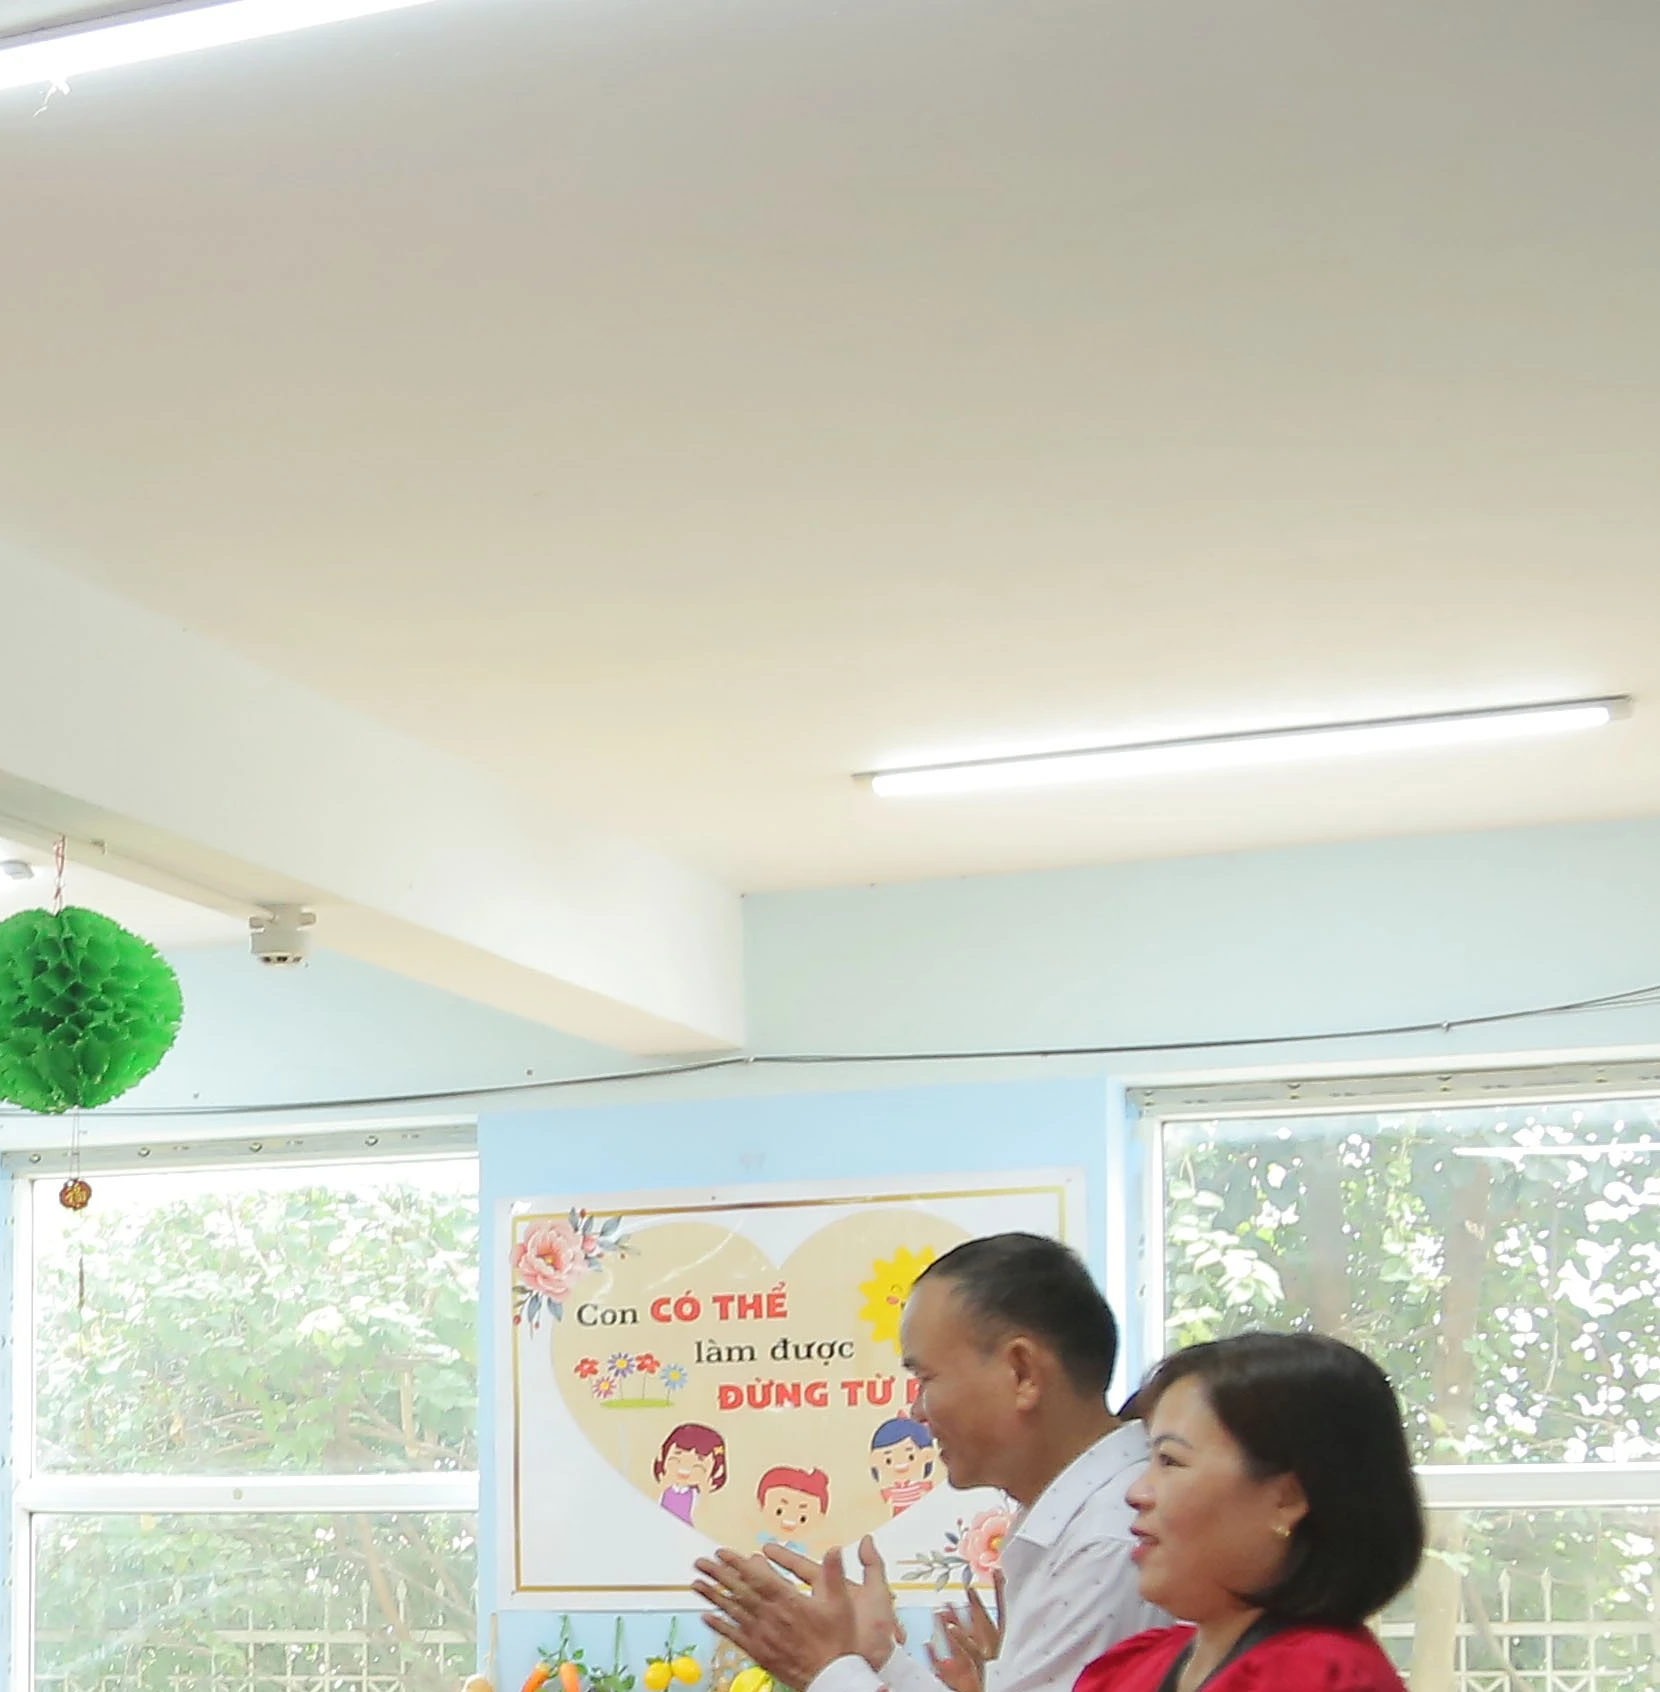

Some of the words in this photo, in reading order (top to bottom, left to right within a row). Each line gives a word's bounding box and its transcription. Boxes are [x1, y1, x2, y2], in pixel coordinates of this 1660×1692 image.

[577, 1302, 638, 1327] Con
[650, 1290, 701, 1323] CÓ
[712, 1281, 788, 1321] THỂ
[694, 1339, 757, 1364] làm
[771, 1336, 855, 1367] được
[717, 1377, 830, 1411] ĐỪNG
[840, 1372, 896, 1407] TỪ
